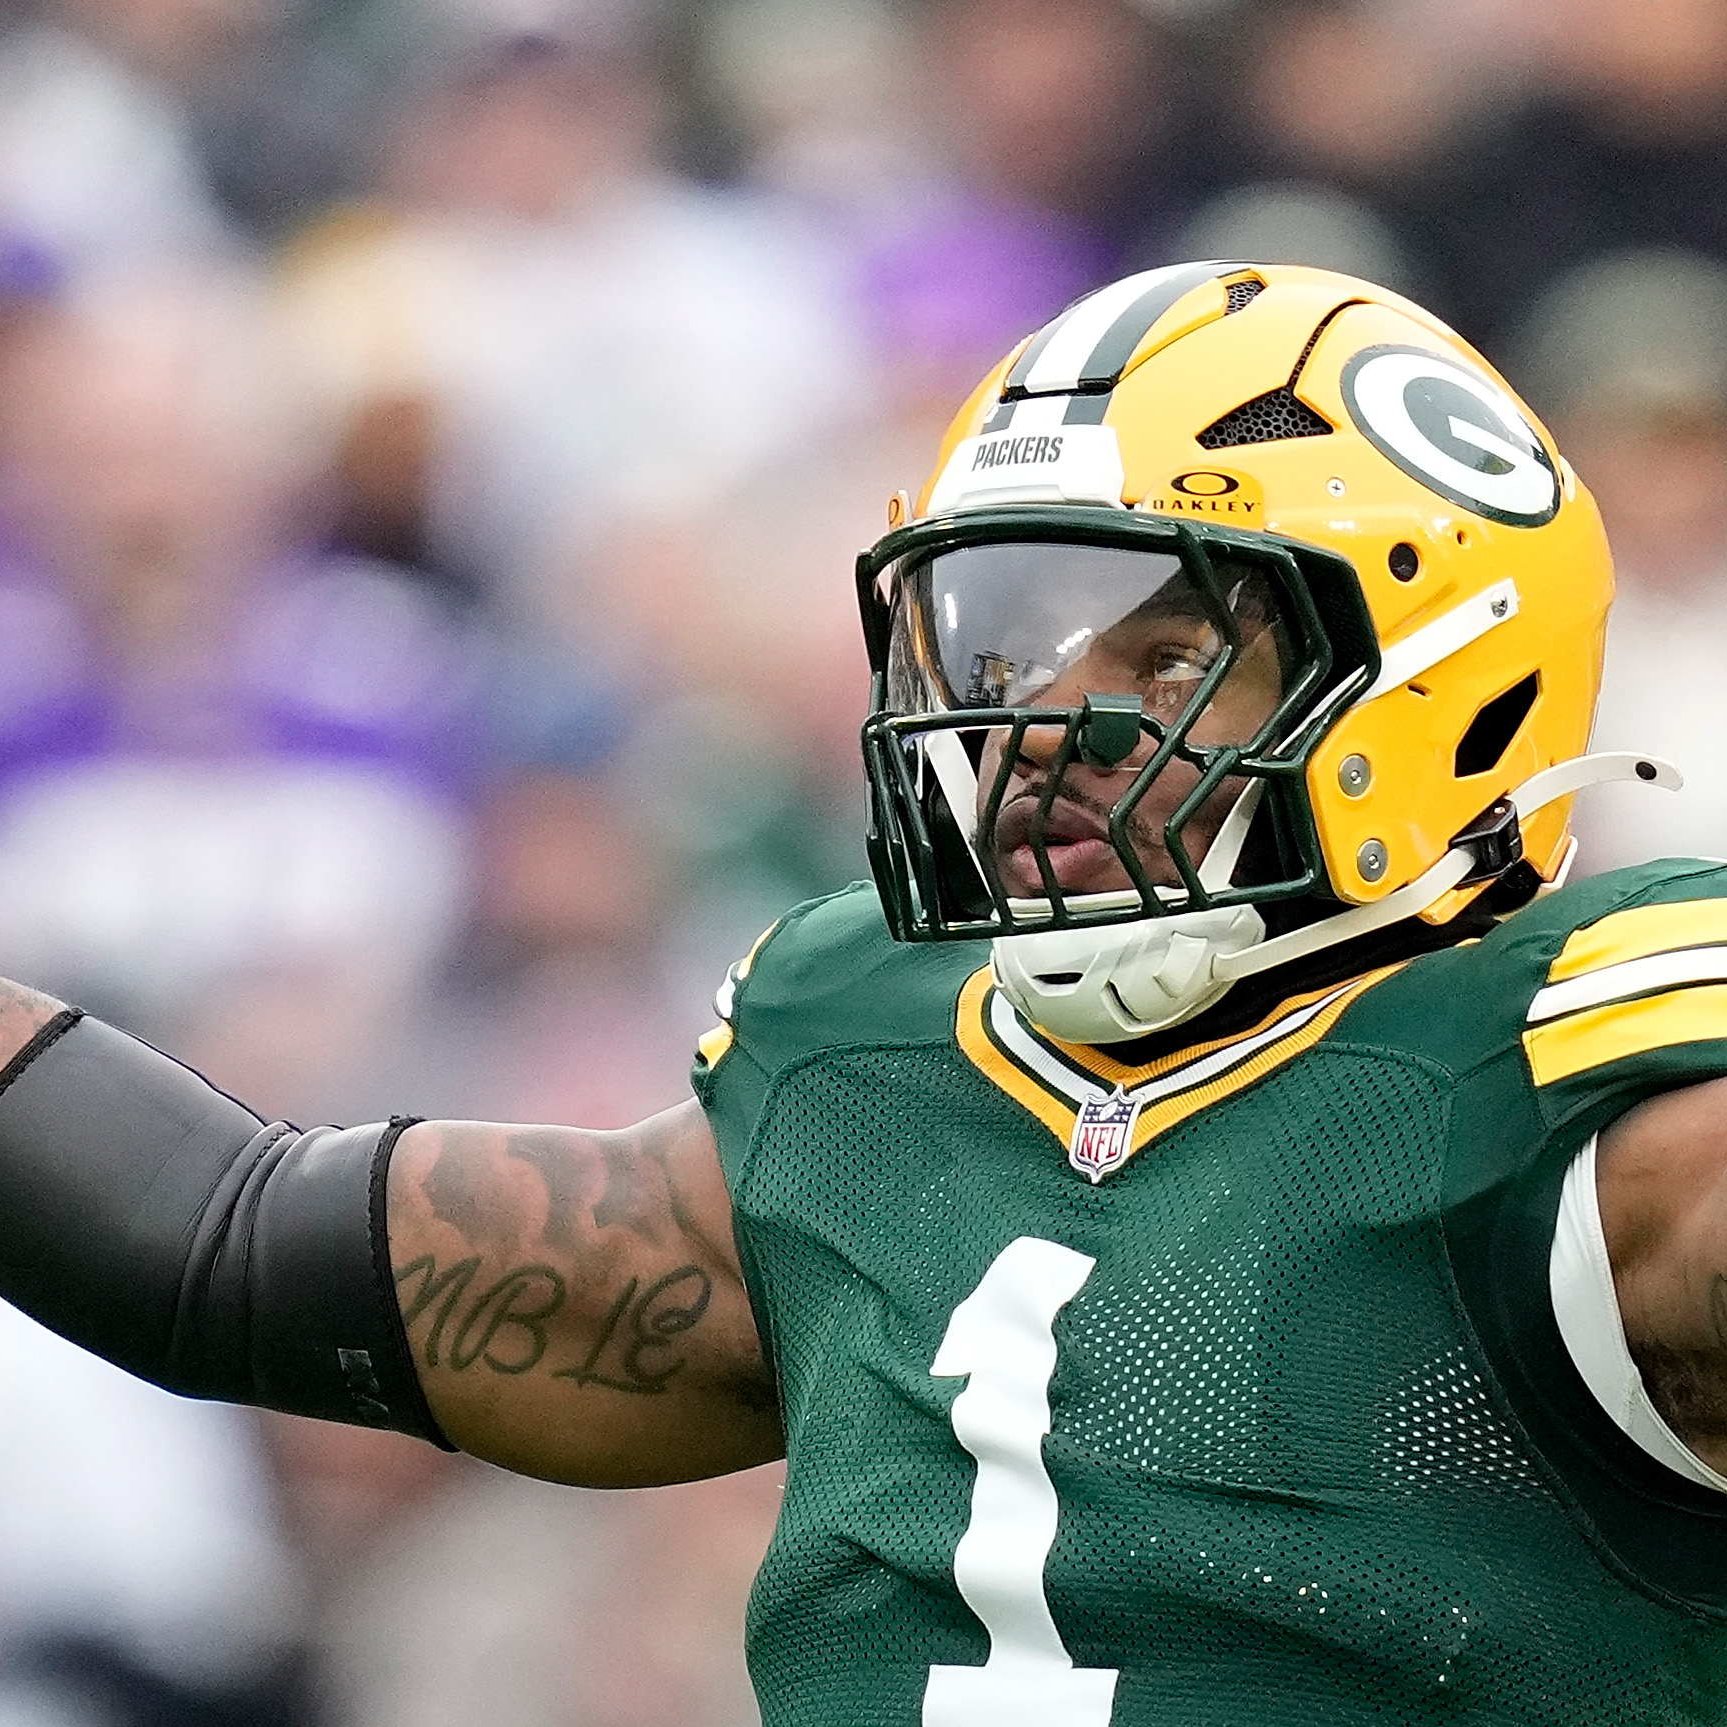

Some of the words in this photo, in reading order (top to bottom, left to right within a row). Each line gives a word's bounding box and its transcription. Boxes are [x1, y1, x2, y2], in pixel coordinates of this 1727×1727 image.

[971, 435, 1064, 472] PACKERS
[1153, 499, 1256, 513] OAKLEY
[1078, 1126, 1119, 1164] NFL
